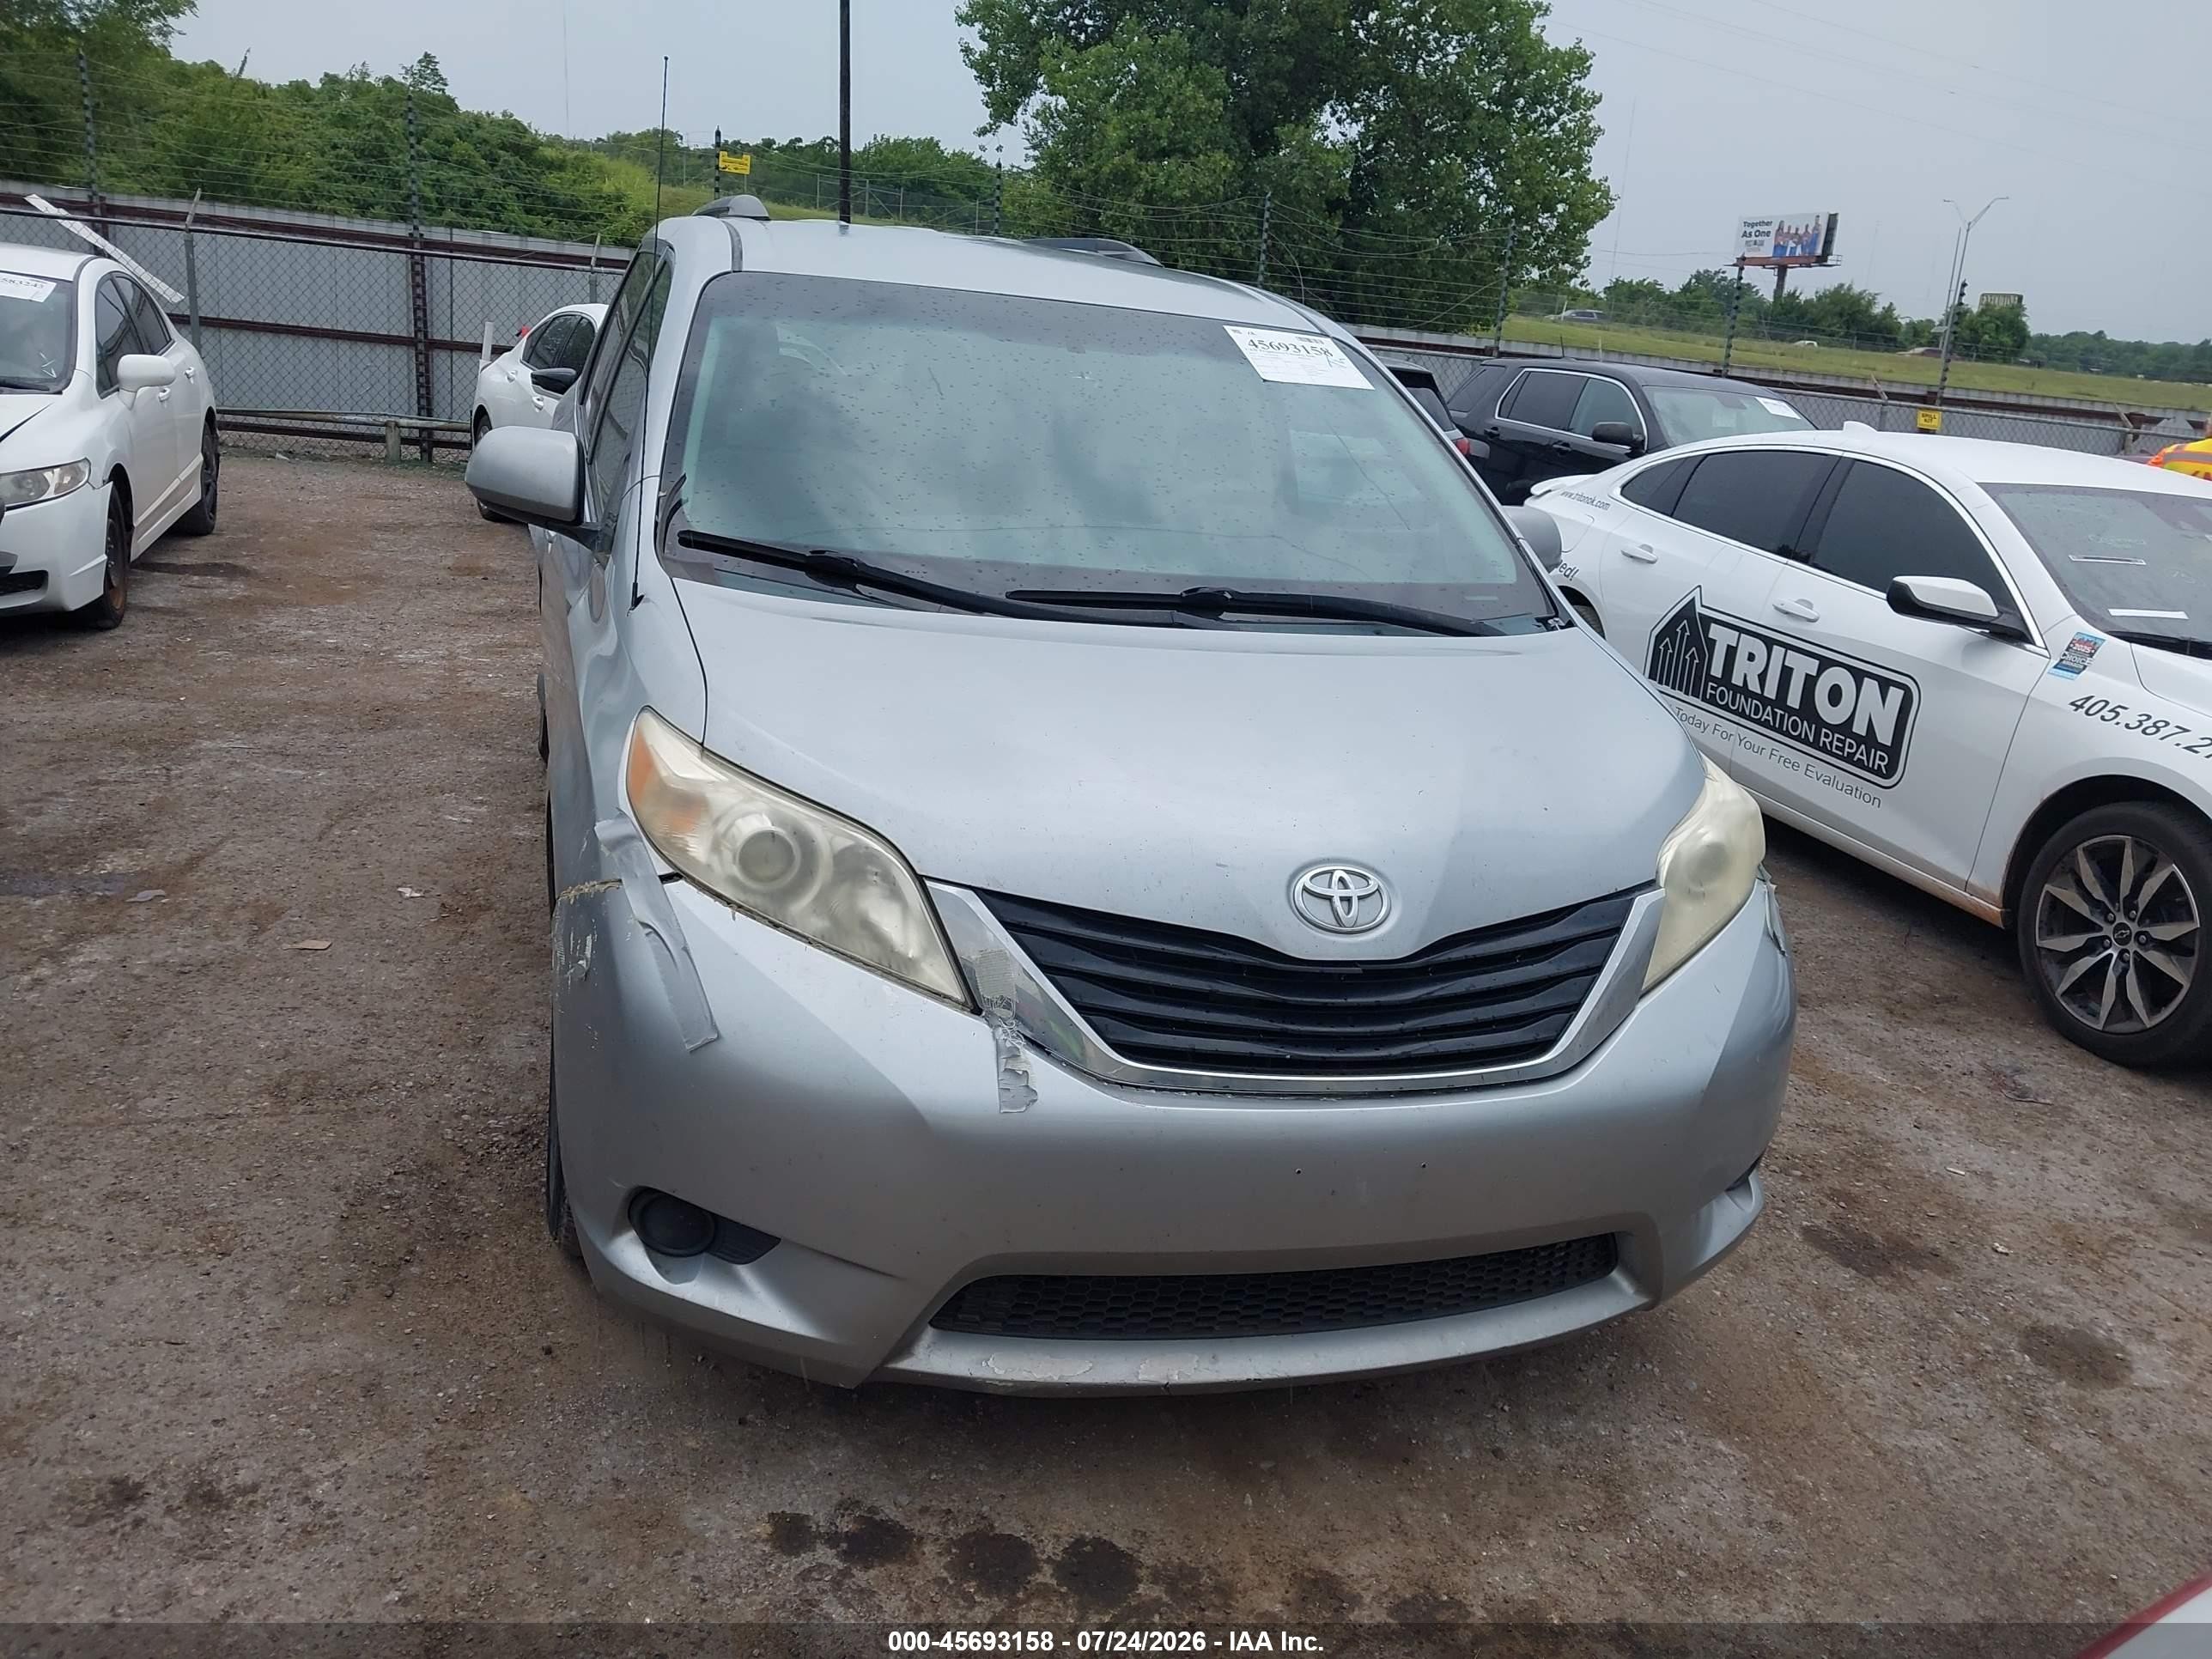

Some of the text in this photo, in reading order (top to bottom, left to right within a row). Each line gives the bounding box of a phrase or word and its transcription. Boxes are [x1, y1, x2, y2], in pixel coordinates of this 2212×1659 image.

[1743, 220, 1772, 228] Together
[1754, 229, 1771, 238] One
[1248, 338, 1334, 357] 45693158
[2061, 651, 2095, 666] CHOICE
[1708, 623, 1905, 746] TRITON
[1706, 683, 1889, 774] FOUNDATION REPAIR
[1675, 708, 1881, 808] Today For Your Free Evaluation
